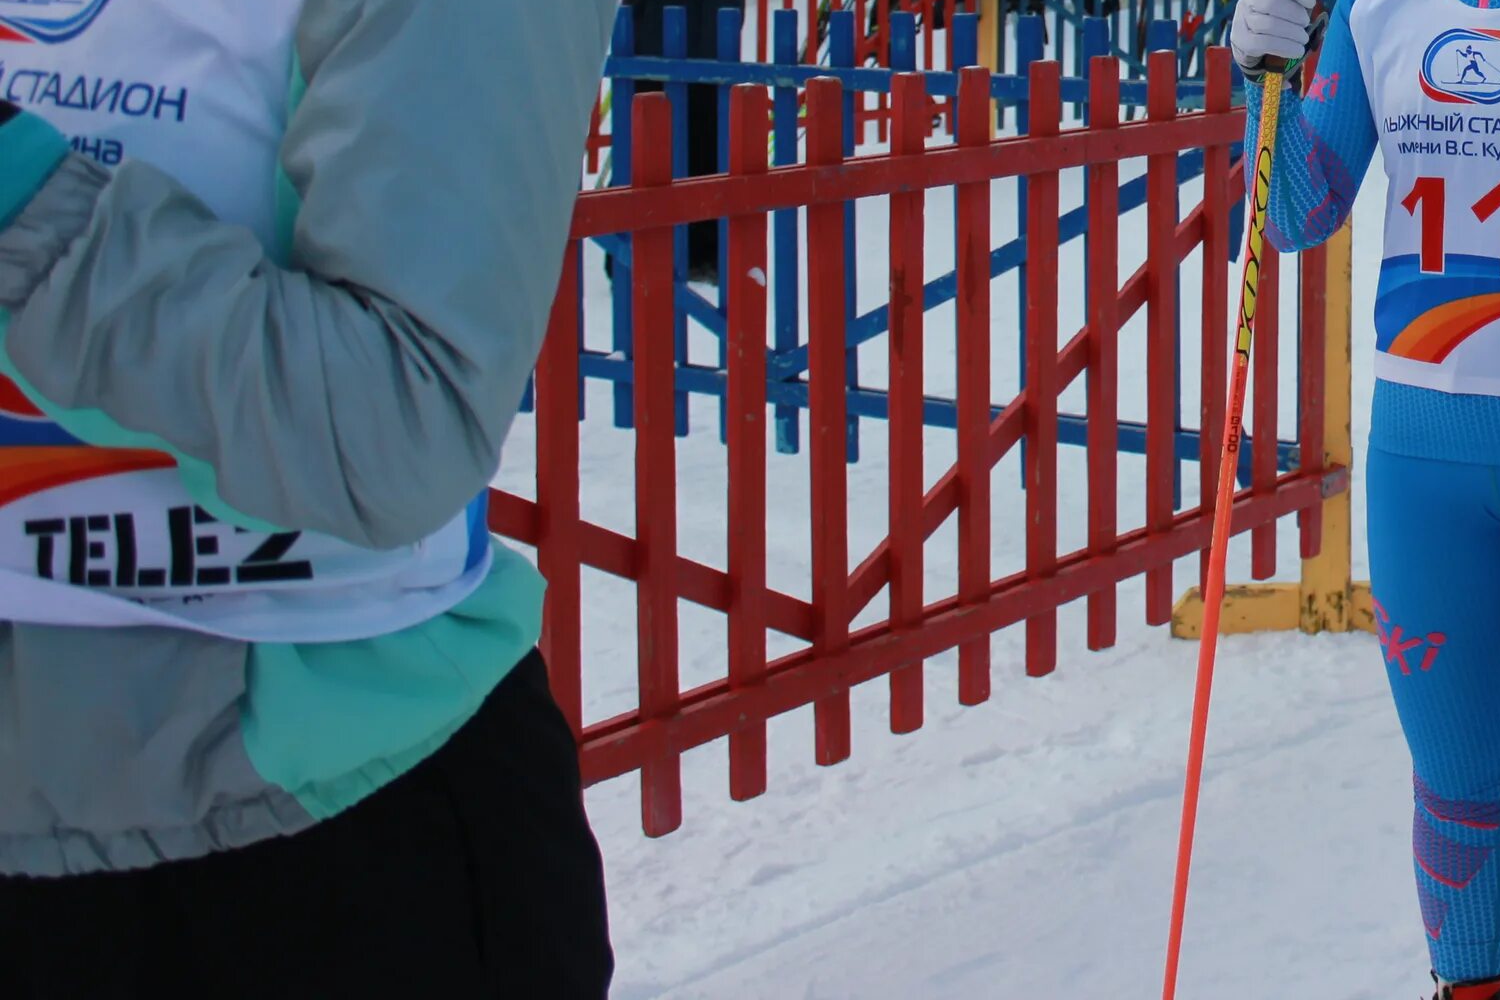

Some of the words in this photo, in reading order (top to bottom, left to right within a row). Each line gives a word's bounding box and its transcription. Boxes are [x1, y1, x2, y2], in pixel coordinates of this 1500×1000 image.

[6, 69, 188, 122] СТАДИОН
[1383, 112, 1463, 133] ЛЫЖНЫЙ
[1445, 140, 1478, 156] В.С.
